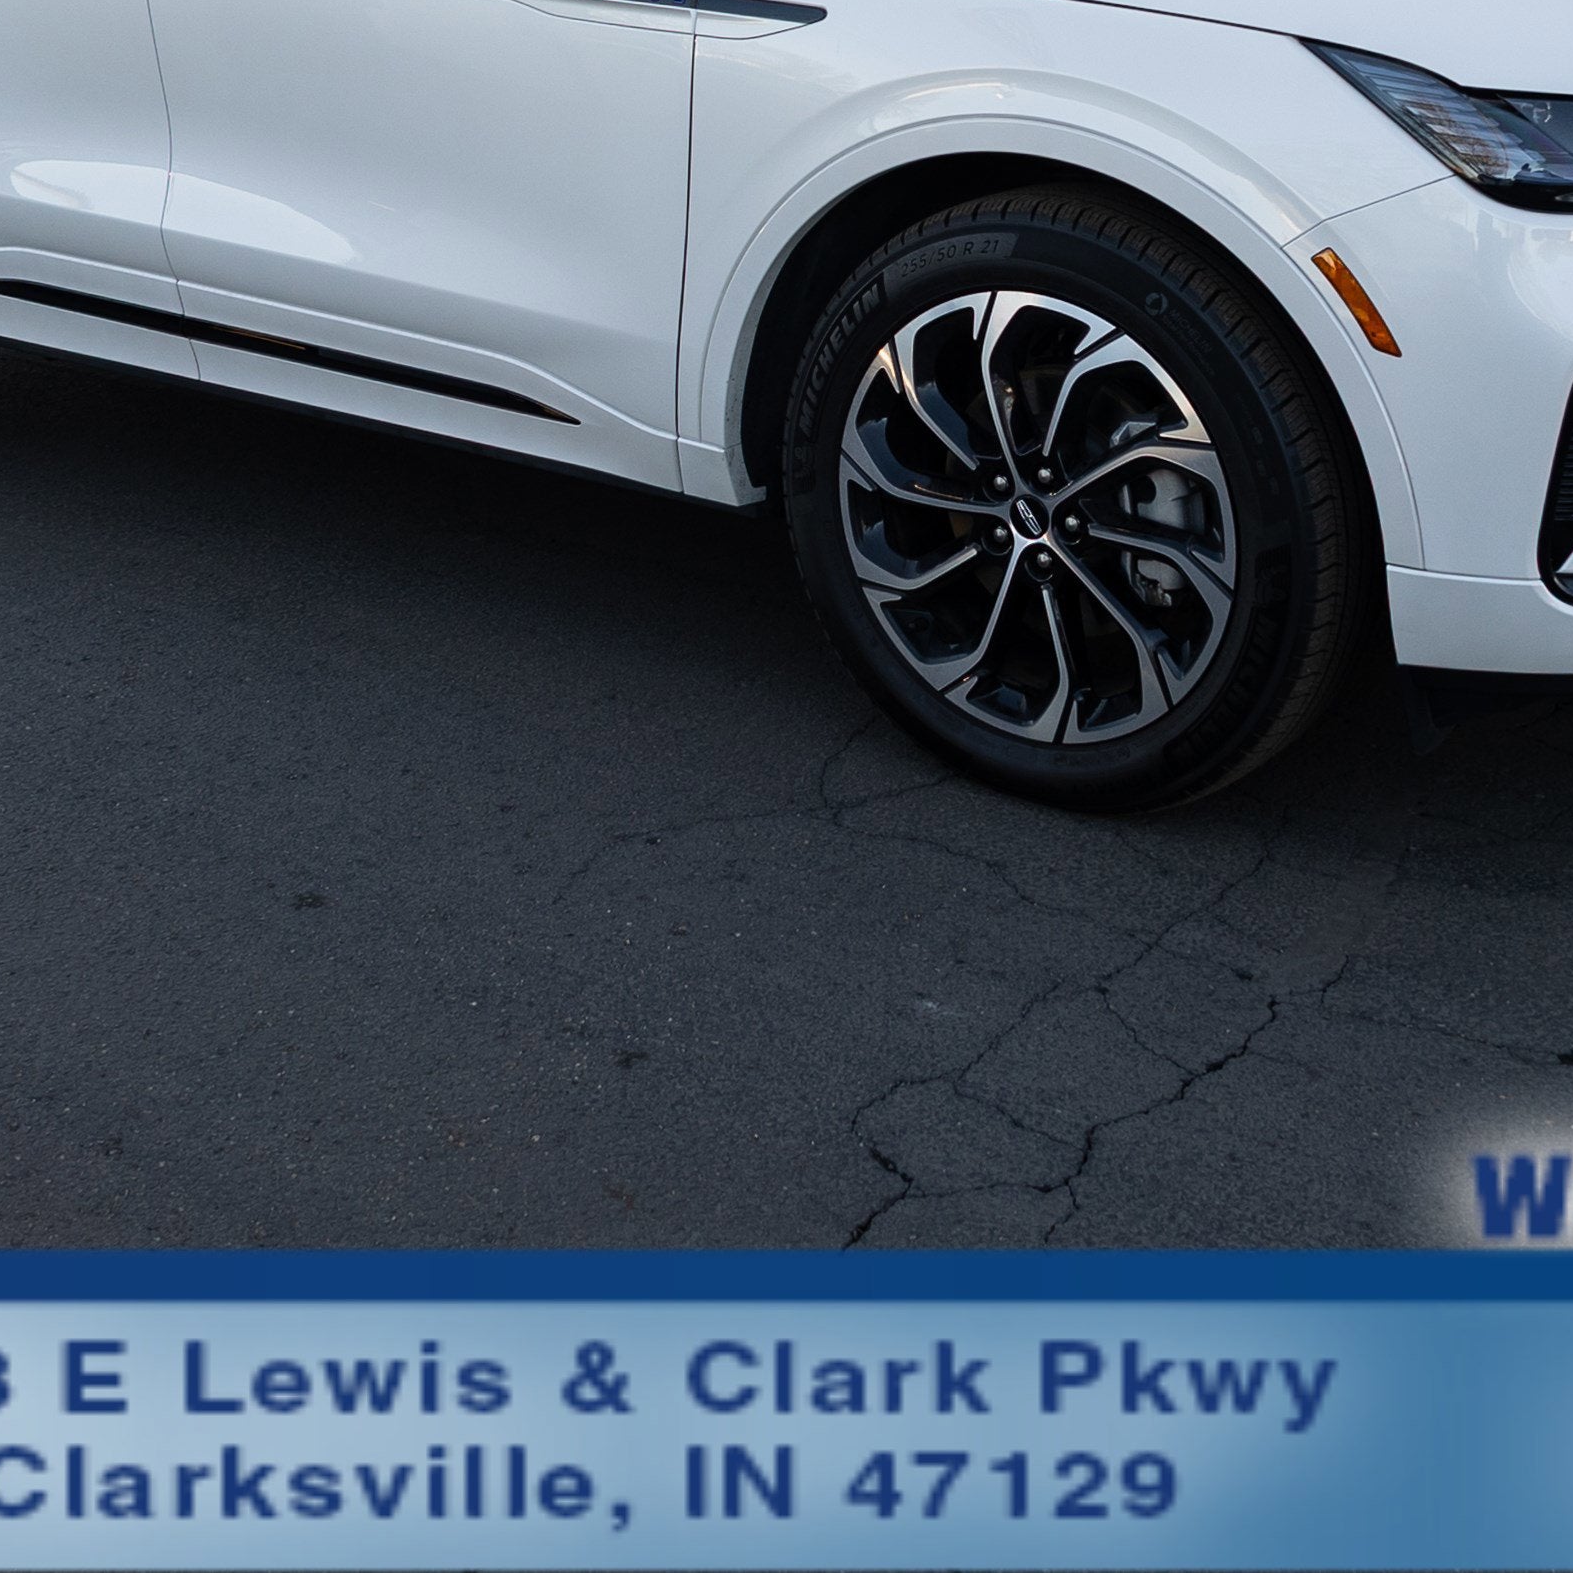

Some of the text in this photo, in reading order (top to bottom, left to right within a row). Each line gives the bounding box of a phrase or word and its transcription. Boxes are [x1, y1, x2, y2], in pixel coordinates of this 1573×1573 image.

[900, 238, 1000, 278] 255/50 R 21
[798, 282, 884, 438] MICHELIN
